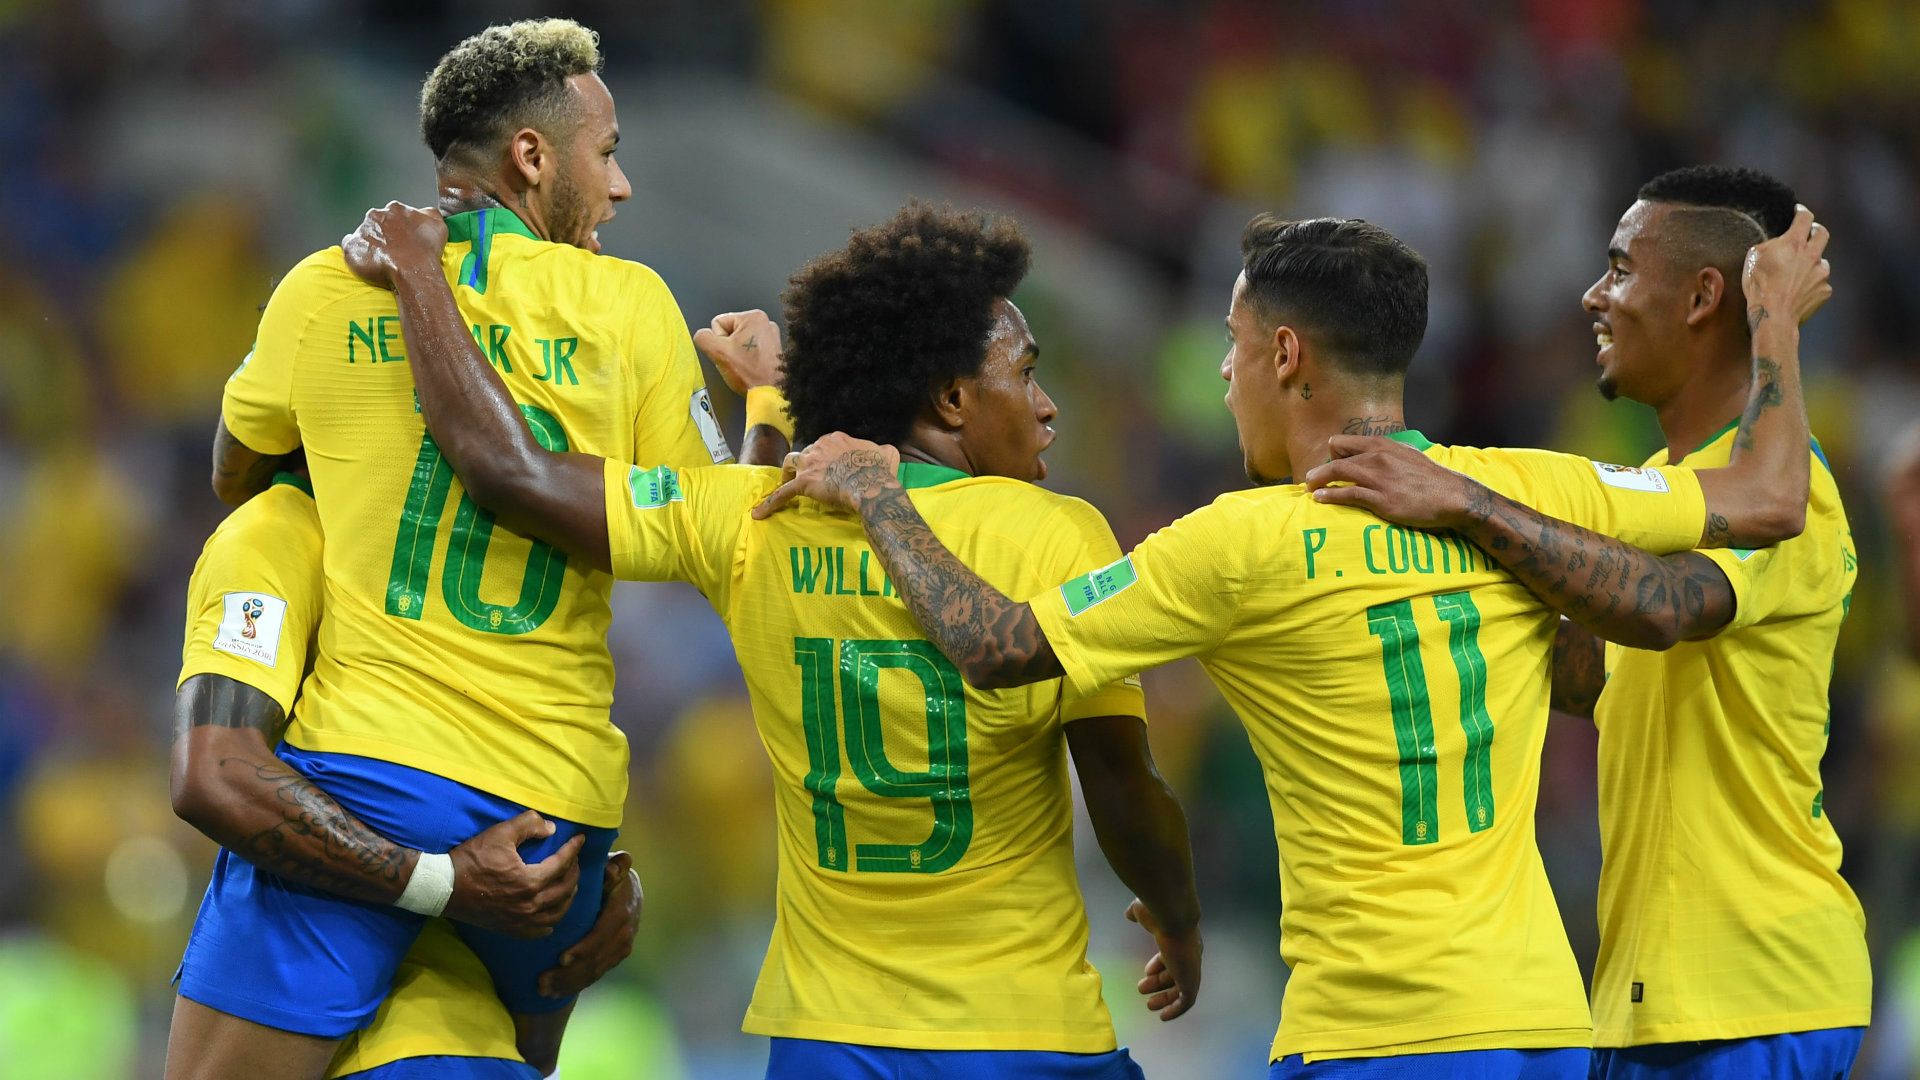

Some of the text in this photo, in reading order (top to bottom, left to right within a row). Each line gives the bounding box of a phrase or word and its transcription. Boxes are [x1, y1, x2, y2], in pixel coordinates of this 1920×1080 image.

[348, 316, 580, 386] NEAR JR
[385, 390, 569, 635] 10
[650, 482, 659, 503] FIFA
[1303, 524, 1499, 580] P. COUTI
[1083, 585, 1095, 602] FIFA
[1096, 574, 1108, 595] BALL
[1103, 570, 1117, 591] ING
[1366, 591, 1494, 845] 11
[794, 636, 974, 874] 19
